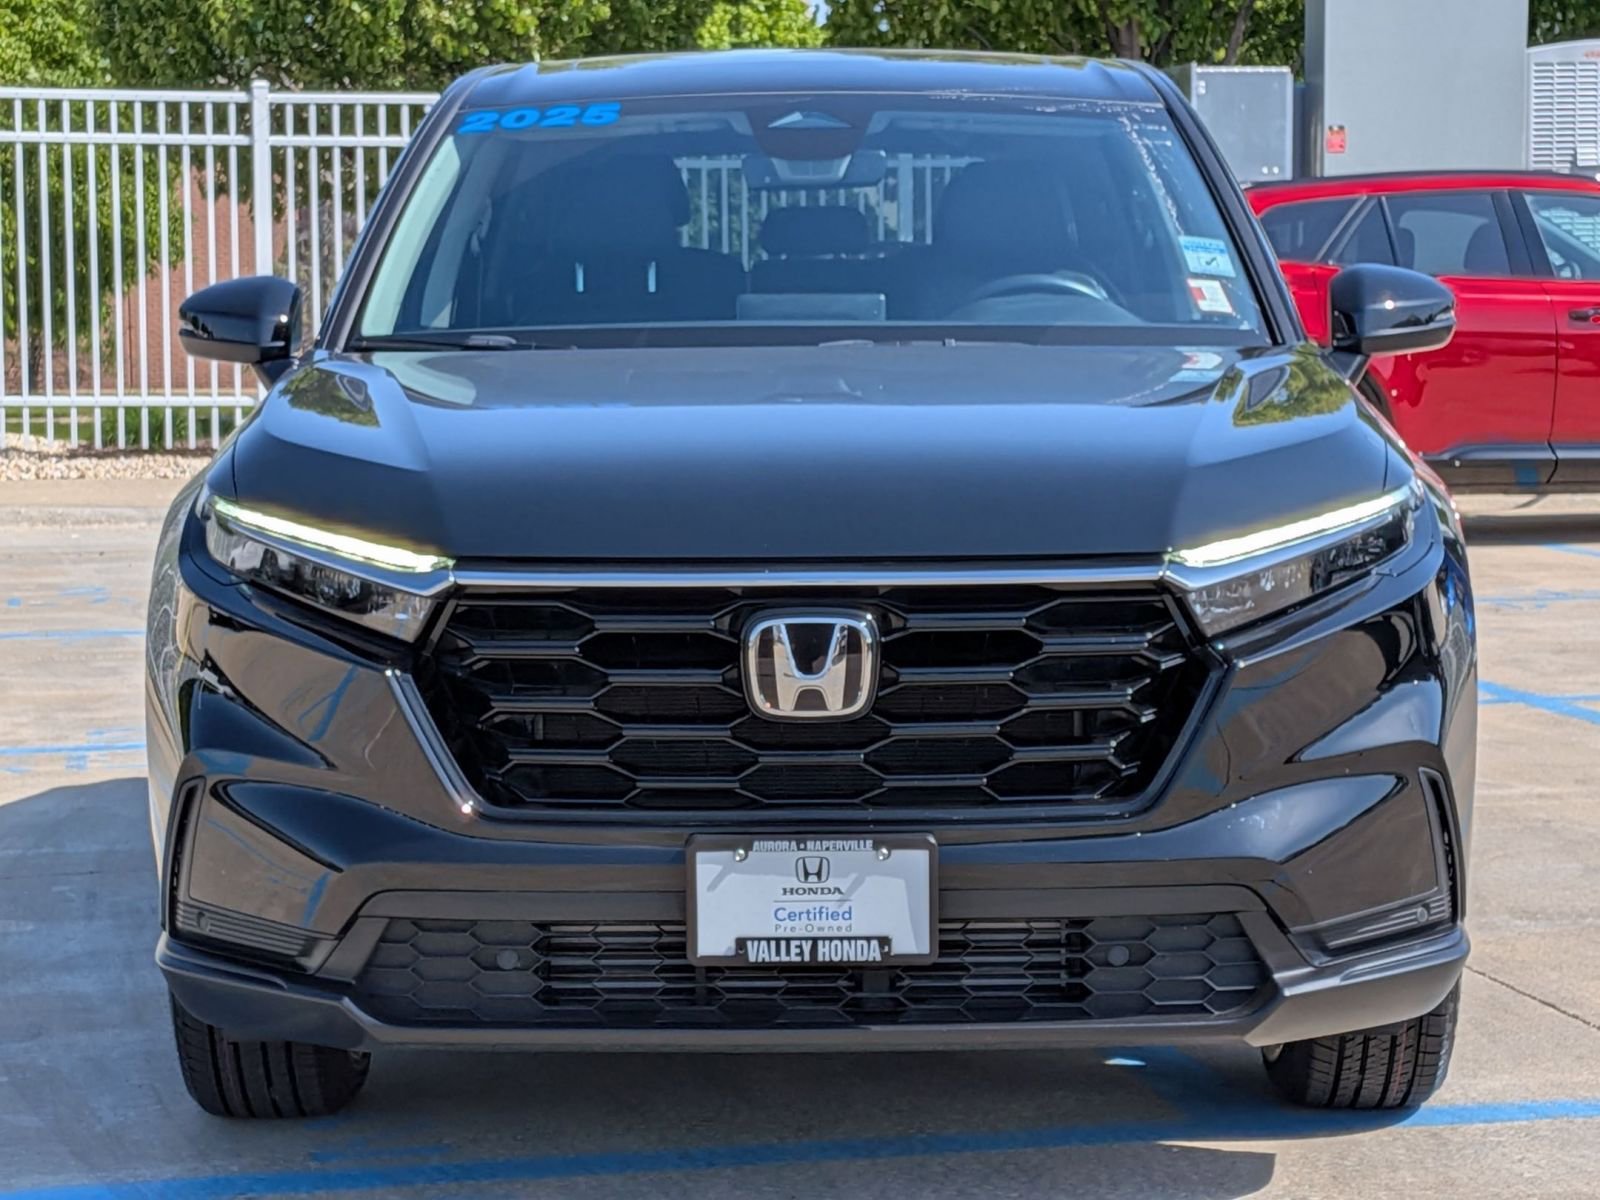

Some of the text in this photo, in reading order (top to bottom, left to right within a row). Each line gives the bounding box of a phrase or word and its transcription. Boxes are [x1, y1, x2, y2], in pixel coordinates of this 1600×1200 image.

[457, 102, 622, 134] 2025
[752, 839, 874, 852] AURORA NAPERVILLE
[782, 887, 845, 896] HONDA
[773, 905, 852, 921] Certified
[774, 923, 853, 933] Pre-Owned
[746, 940, 882, 963] VALLEY HONDA
